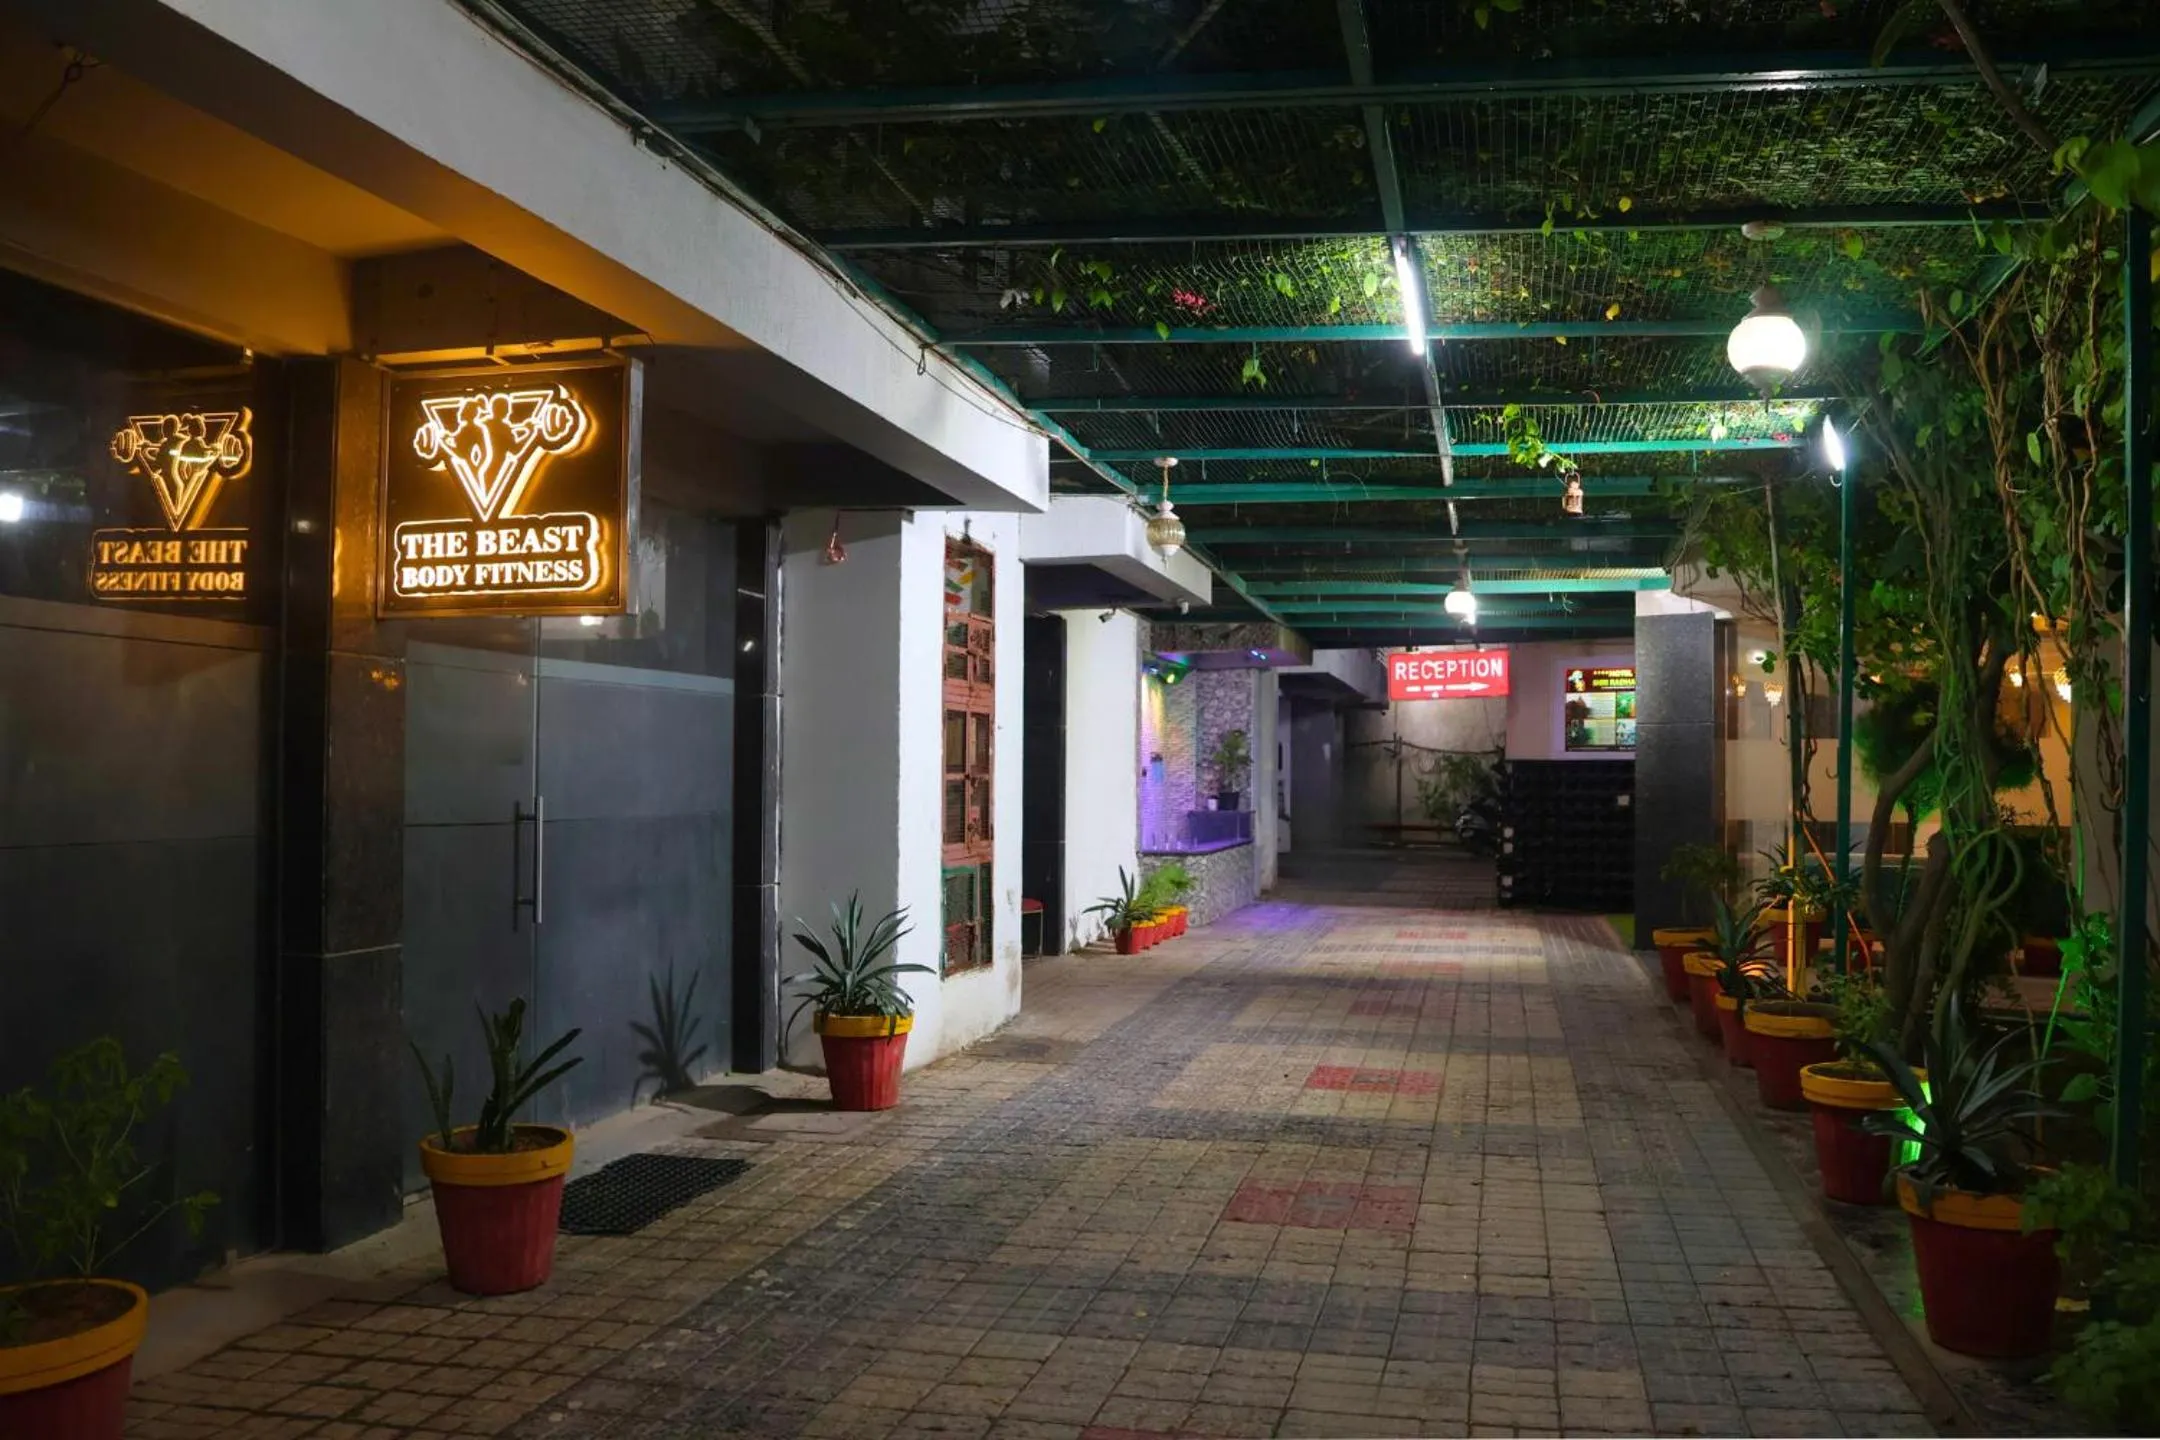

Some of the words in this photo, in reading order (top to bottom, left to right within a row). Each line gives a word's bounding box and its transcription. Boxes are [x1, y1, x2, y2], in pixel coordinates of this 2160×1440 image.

[402, 531, 467, 559] THE
[475, 526, 583, 556] BEAST
[401, 564, 470, 588] BODY
[475, 560, 583, 584] FITNESS
[1394, 657, 1503, 680] RECEPTION
